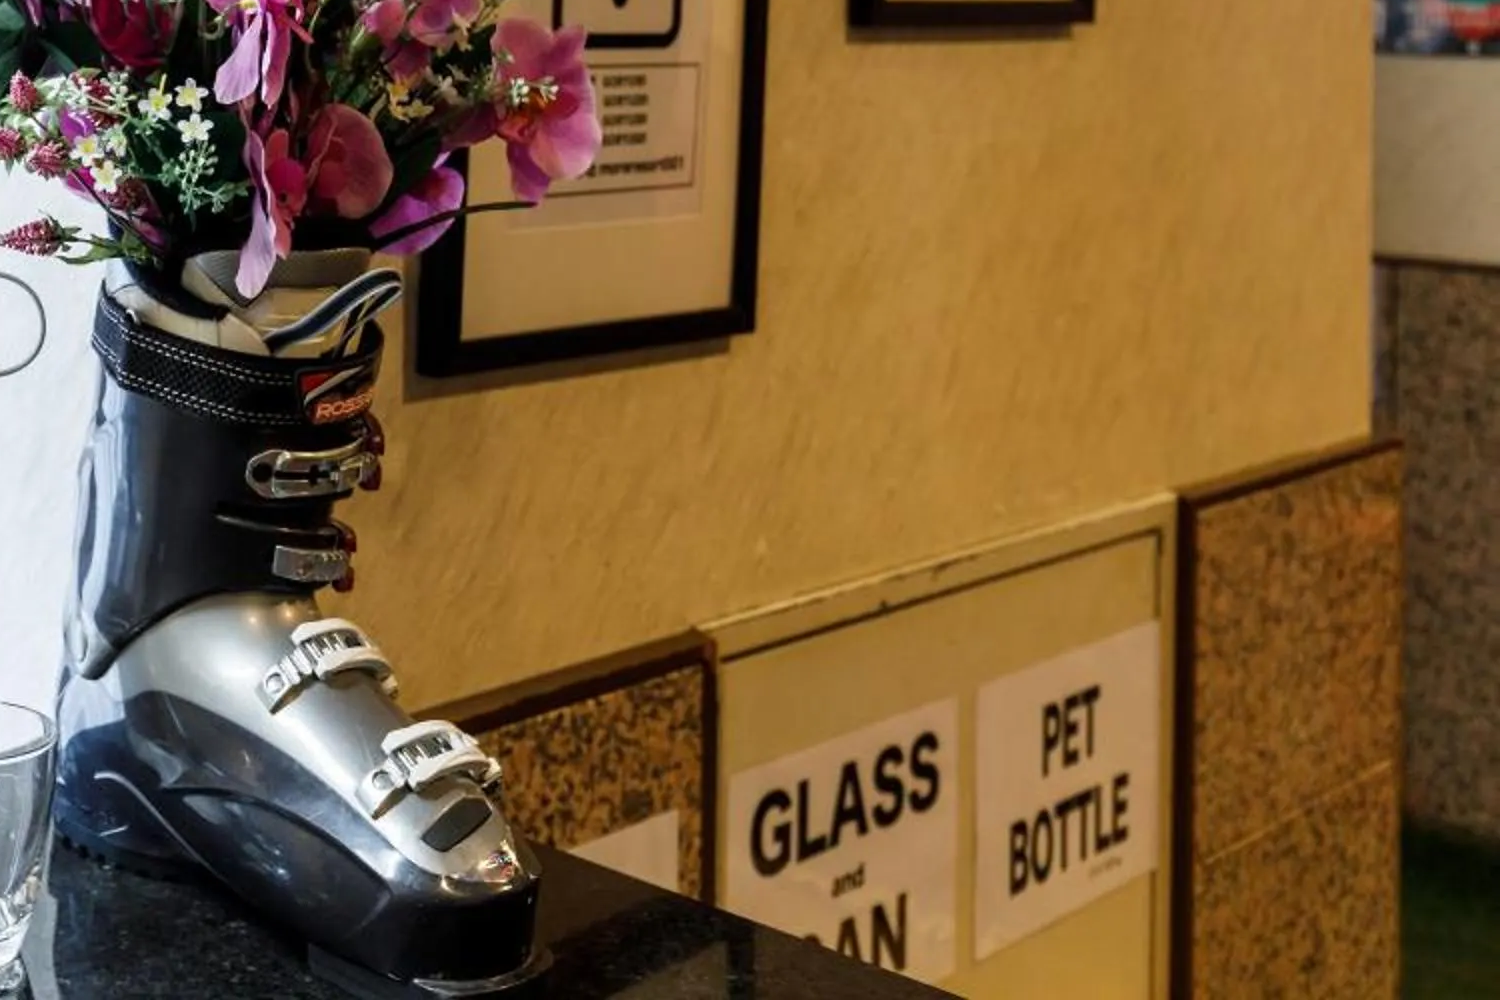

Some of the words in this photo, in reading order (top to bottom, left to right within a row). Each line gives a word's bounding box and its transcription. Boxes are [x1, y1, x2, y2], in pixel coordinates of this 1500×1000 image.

[1042, 685, 1100, 777] PET
[751, 731, 940, 878] GLASS
[1010, 772, 1129, 897] BOTTLE
[831, 862, 864, 897] and
[803, 891, 907, 971] AN
